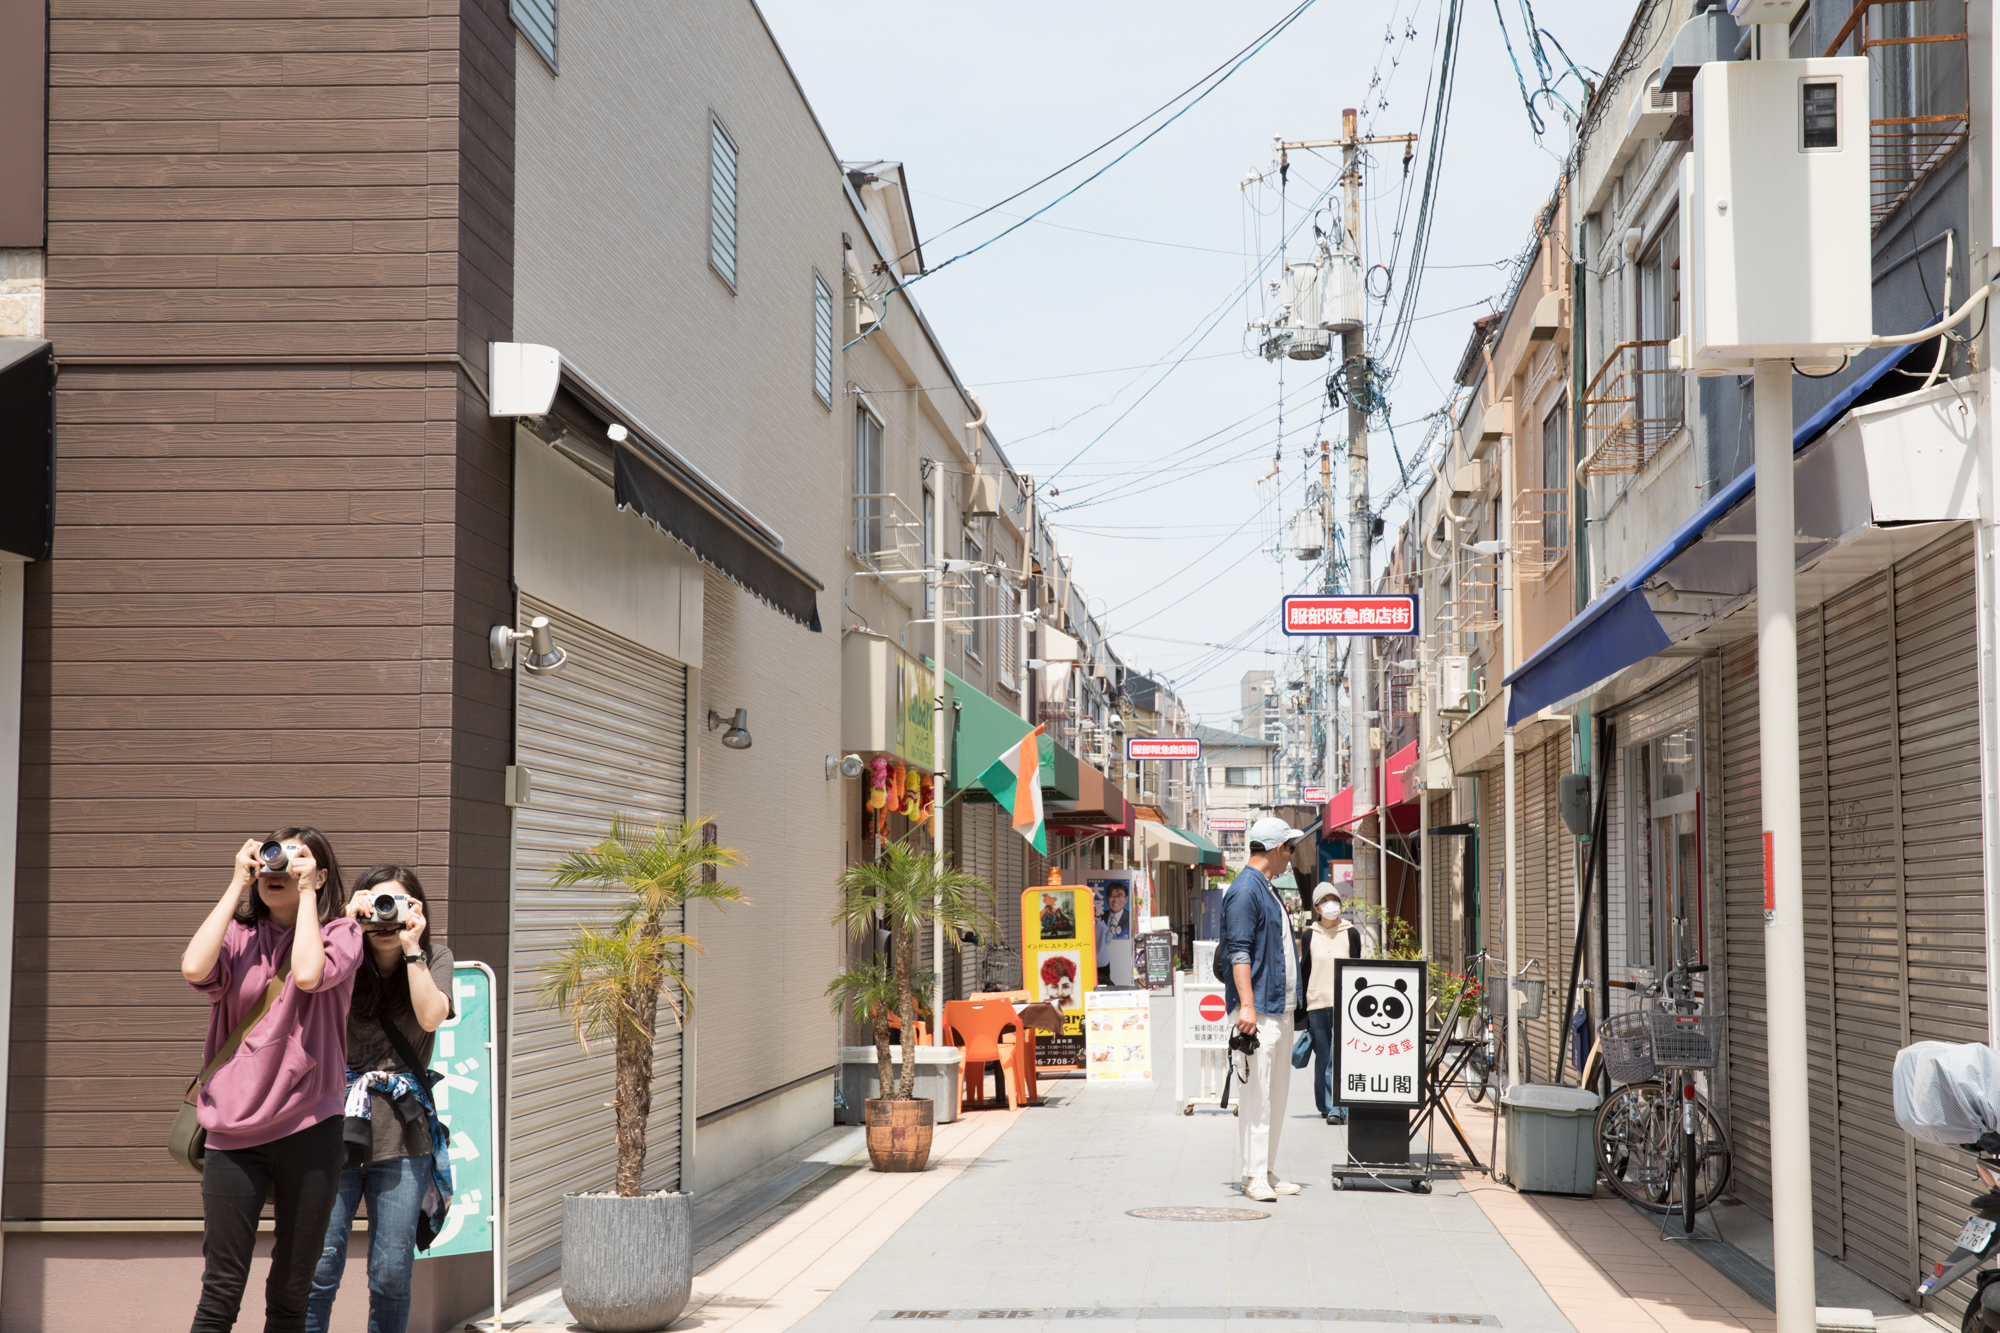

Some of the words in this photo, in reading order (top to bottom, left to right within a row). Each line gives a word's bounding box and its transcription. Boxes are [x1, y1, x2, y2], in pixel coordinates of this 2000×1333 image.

[1290, 607, 1409, 625] 服部阪急商店街
[1132, 744, 1196, 755] 服部阪急商店街
[1346, 1037, 1414, 1056] パンダ食堂
[1348, 1073, 1412, 1094] 晴山閣
